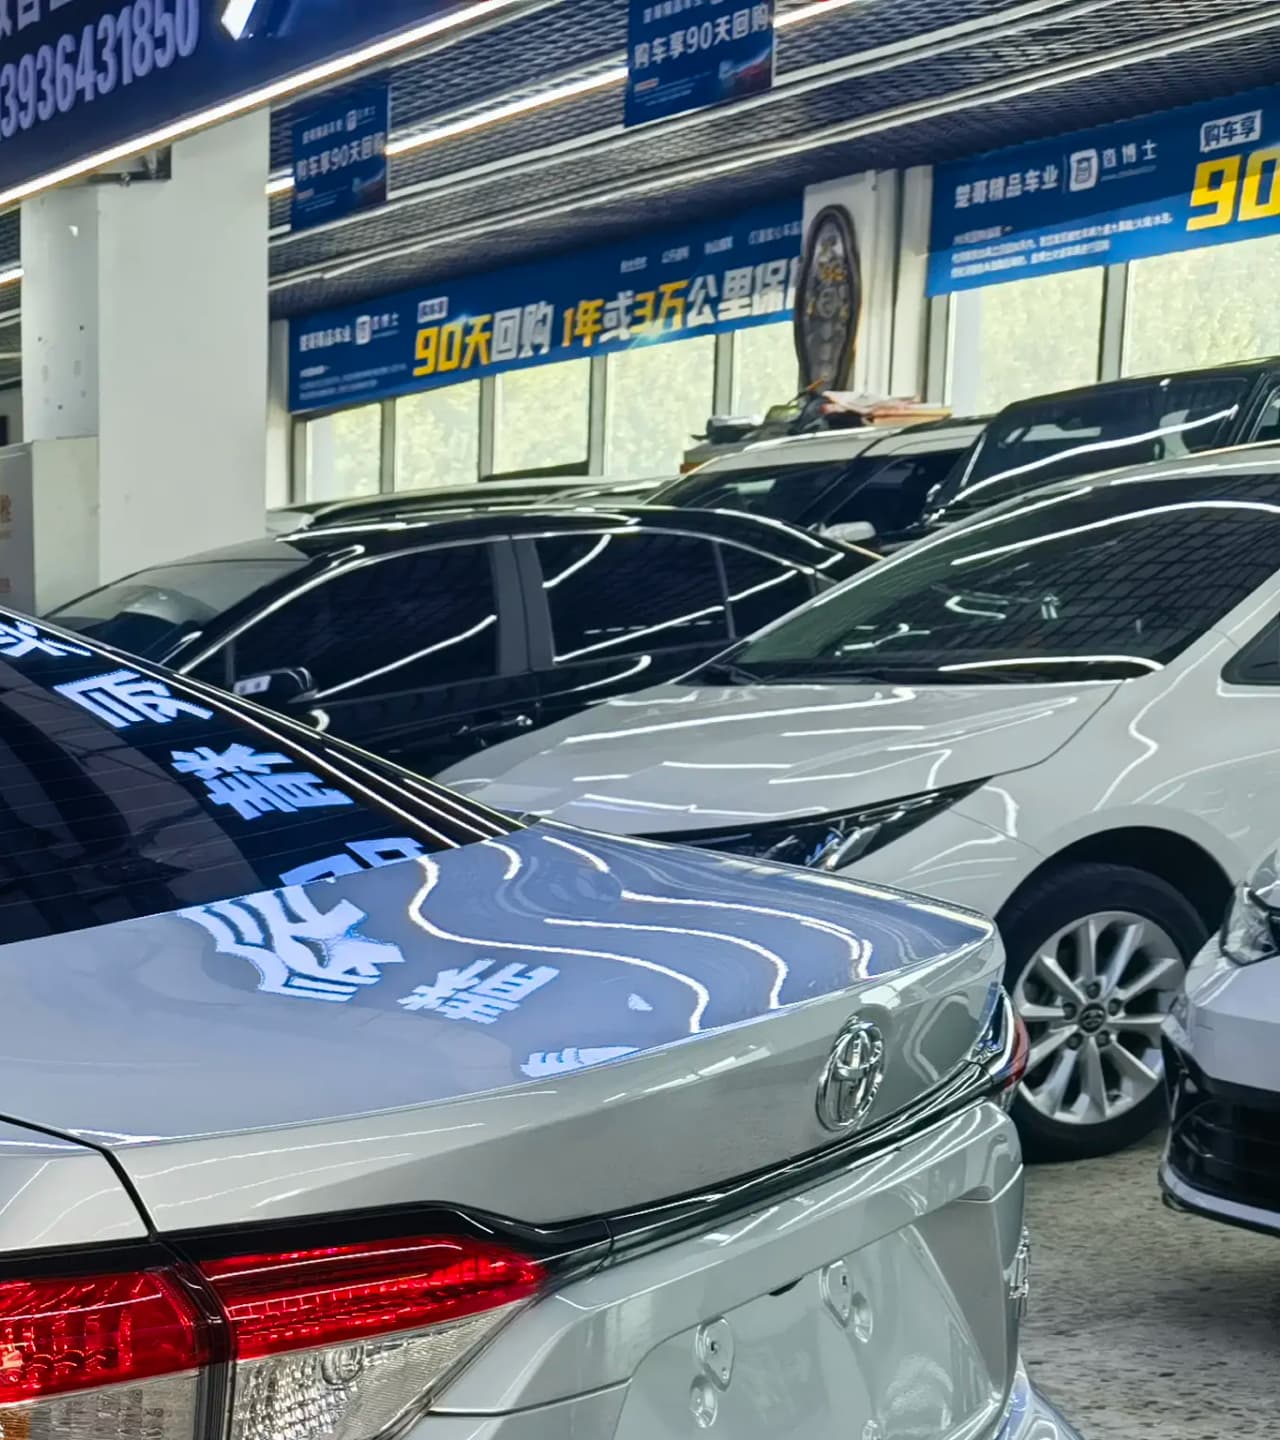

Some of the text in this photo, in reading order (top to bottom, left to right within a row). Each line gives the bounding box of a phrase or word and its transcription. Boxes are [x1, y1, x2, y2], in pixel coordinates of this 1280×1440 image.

[1203, 114, 1258, 148] 购车享
[413, 301, 555, 377] 90天回购
